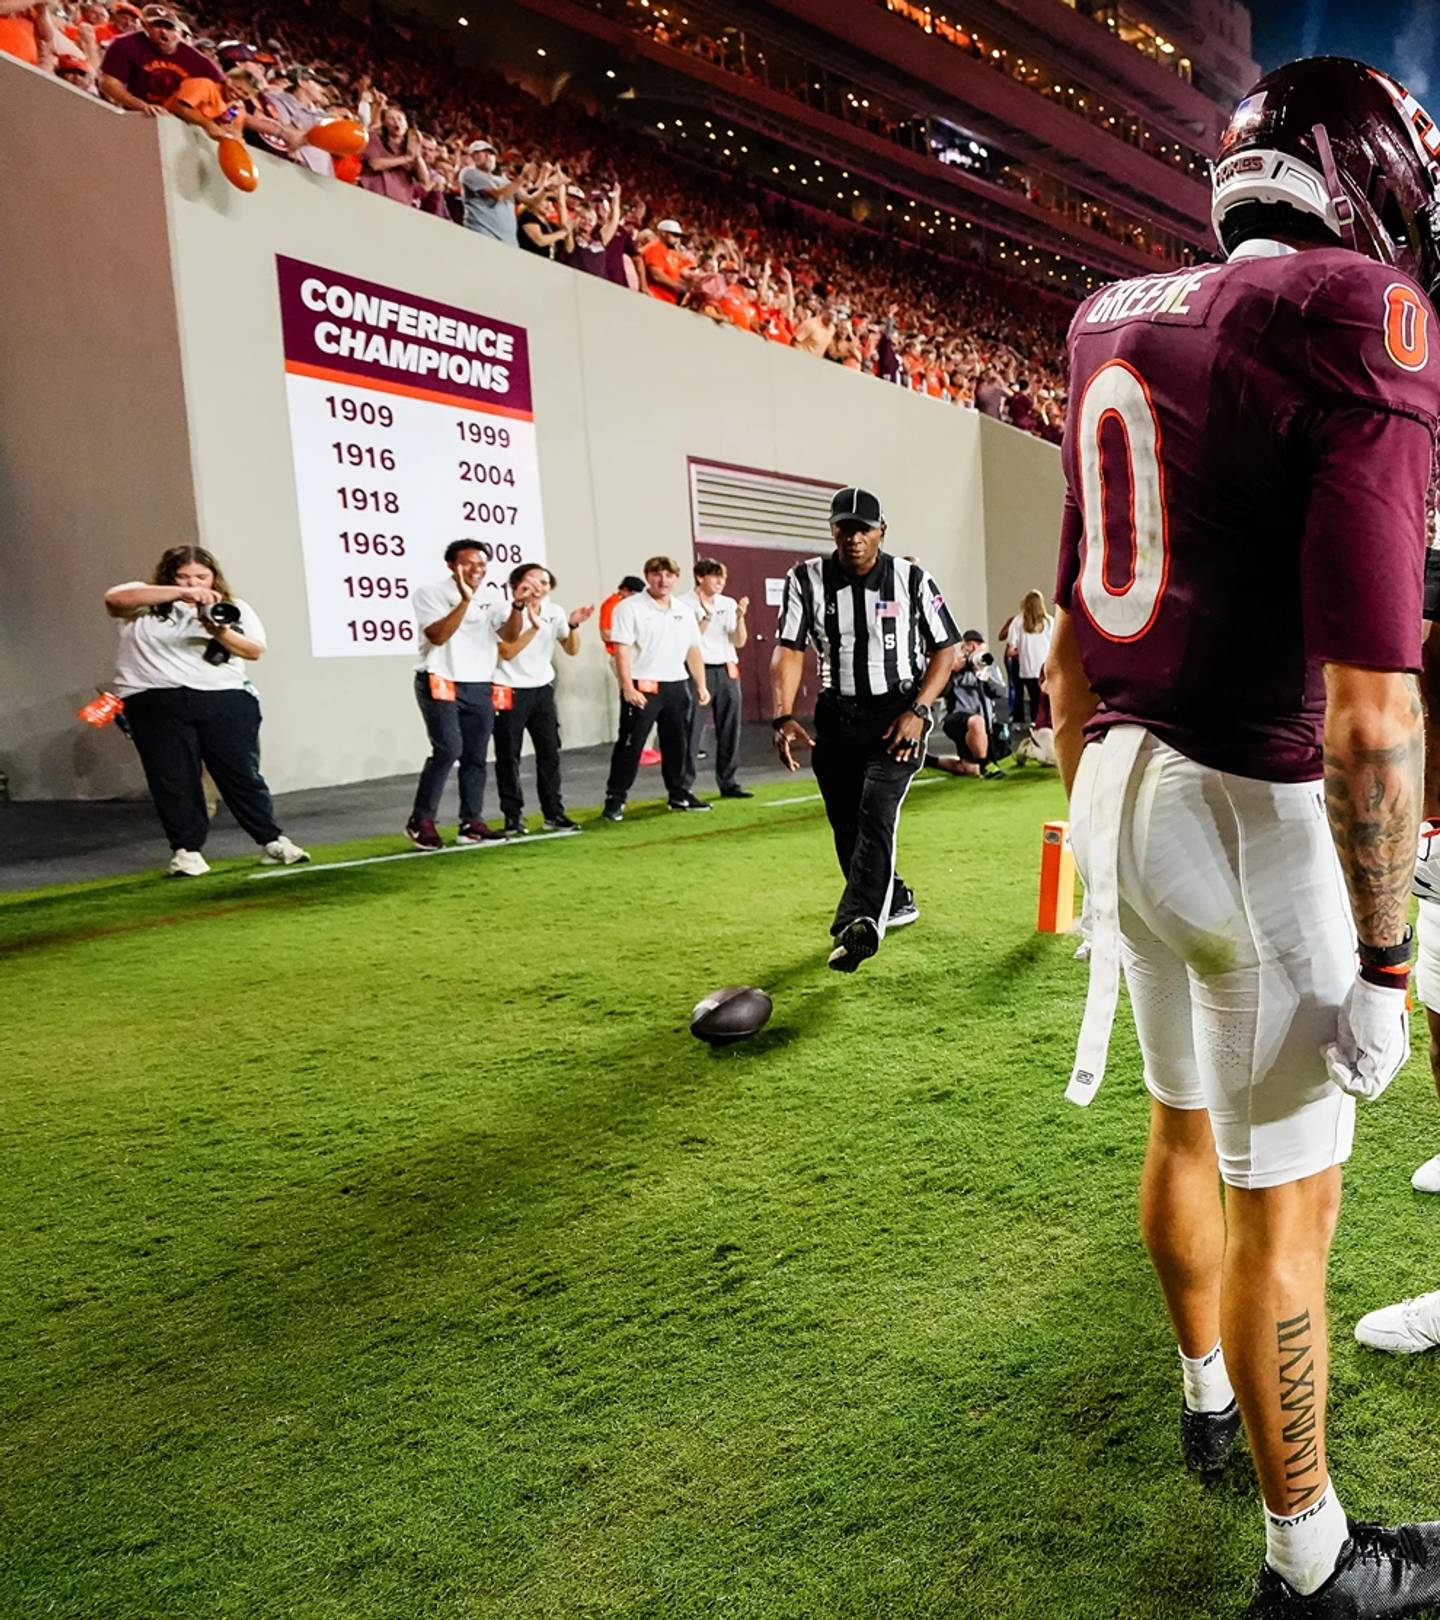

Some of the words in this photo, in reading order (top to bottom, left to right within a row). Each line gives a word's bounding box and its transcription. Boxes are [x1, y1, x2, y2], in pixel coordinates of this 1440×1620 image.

[300, 278, 514, 362] CONFERENCE
[1384, 283, 1428, 371] 0
[314, 321, 510, 394] CHAMPIONS
[325, 396, 394, 428] 1909
[456, 421, 510, 448] 1999
[332, 442, 396, 471] 1916
[458, 461, 515, 487] 2004
[337, 487, 400, 514] 1918
[462, 502, 518, 526] 2007
[1076, 358, 1170, 643] 0
[339, 532, 405, 557] 1963
[483, 542, 522, 563] 008
[343, 576, 409, 599] 1995
[347, 620, 413, 642] 1996
[884, 633, 896, 650] S
[1270, 1495, 1328, 1527] BATTLE
